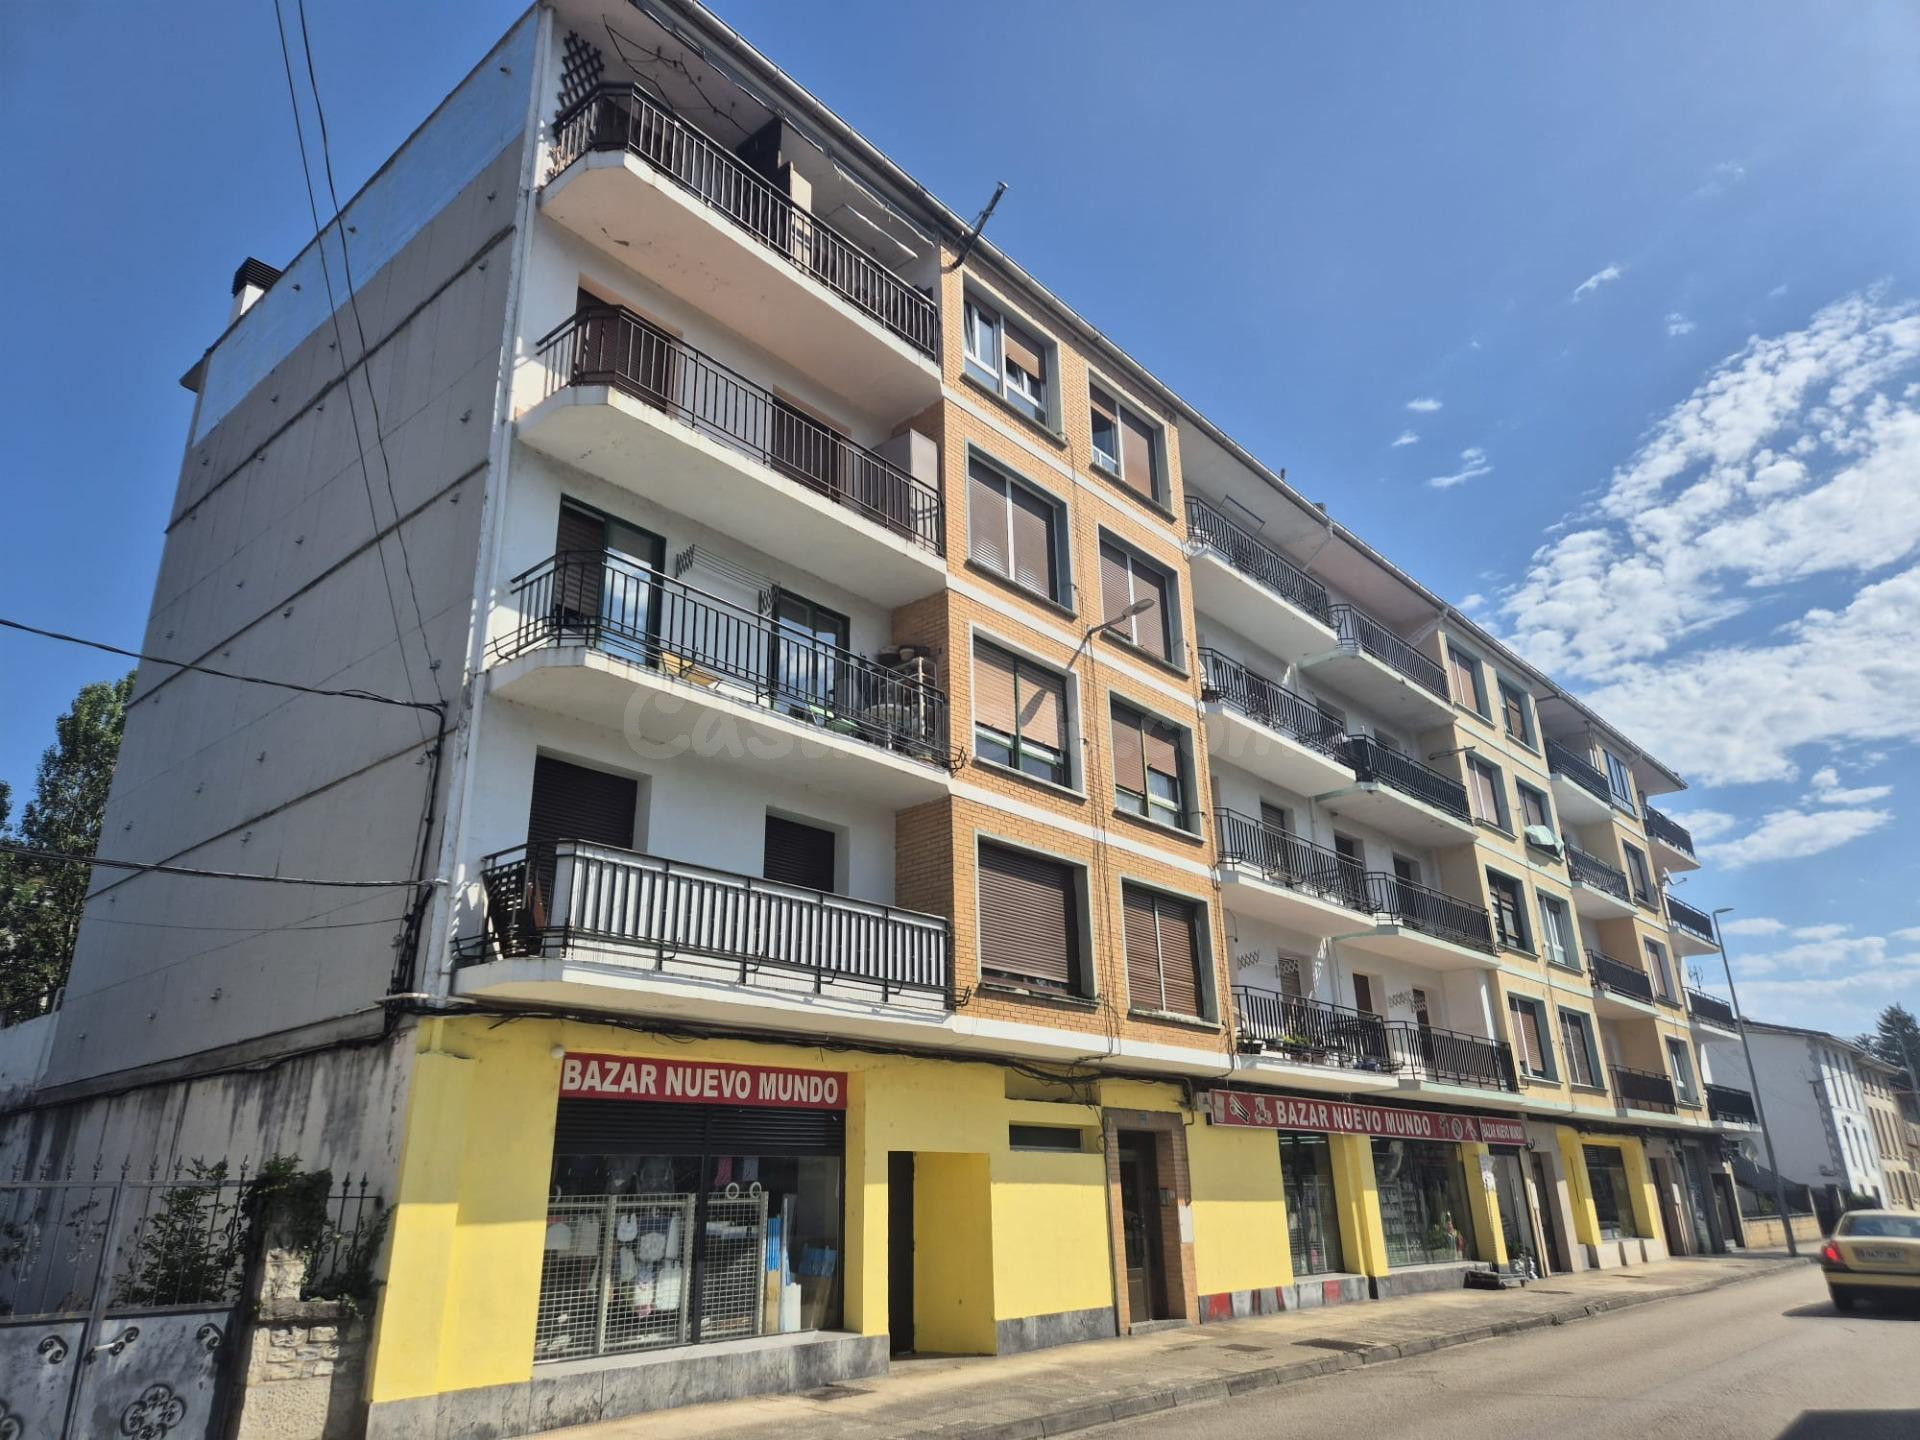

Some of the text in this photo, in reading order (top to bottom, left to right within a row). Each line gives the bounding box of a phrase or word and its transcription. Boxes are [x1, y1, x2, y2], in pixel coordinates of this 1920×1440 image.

[562, 1058, 838, 1104] BAZAR NUEVO MUNDO
[1275, 1100, 1432, 1136] BAZAR NUEVO MUNDO
